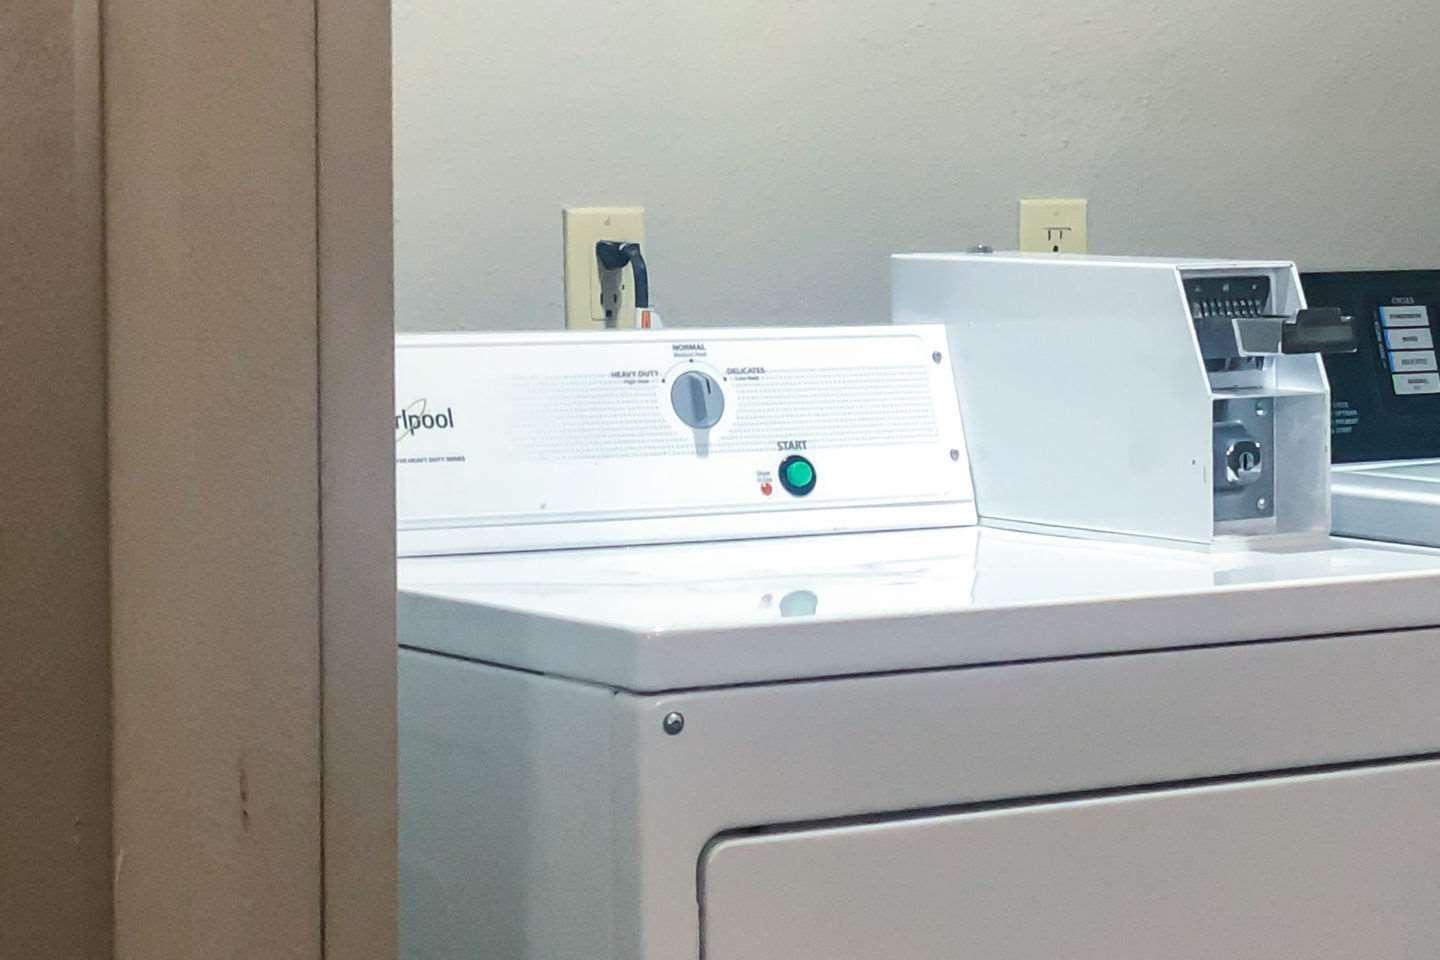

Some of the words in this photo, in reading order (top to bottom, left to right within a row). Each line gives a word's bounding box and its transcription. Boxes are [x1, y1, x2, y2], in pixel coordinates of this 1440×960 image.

[611, 370, 636, 378] HEAVY
[726, 367, 765, 375] DELICATES
[777, 440, 808, 451] START
